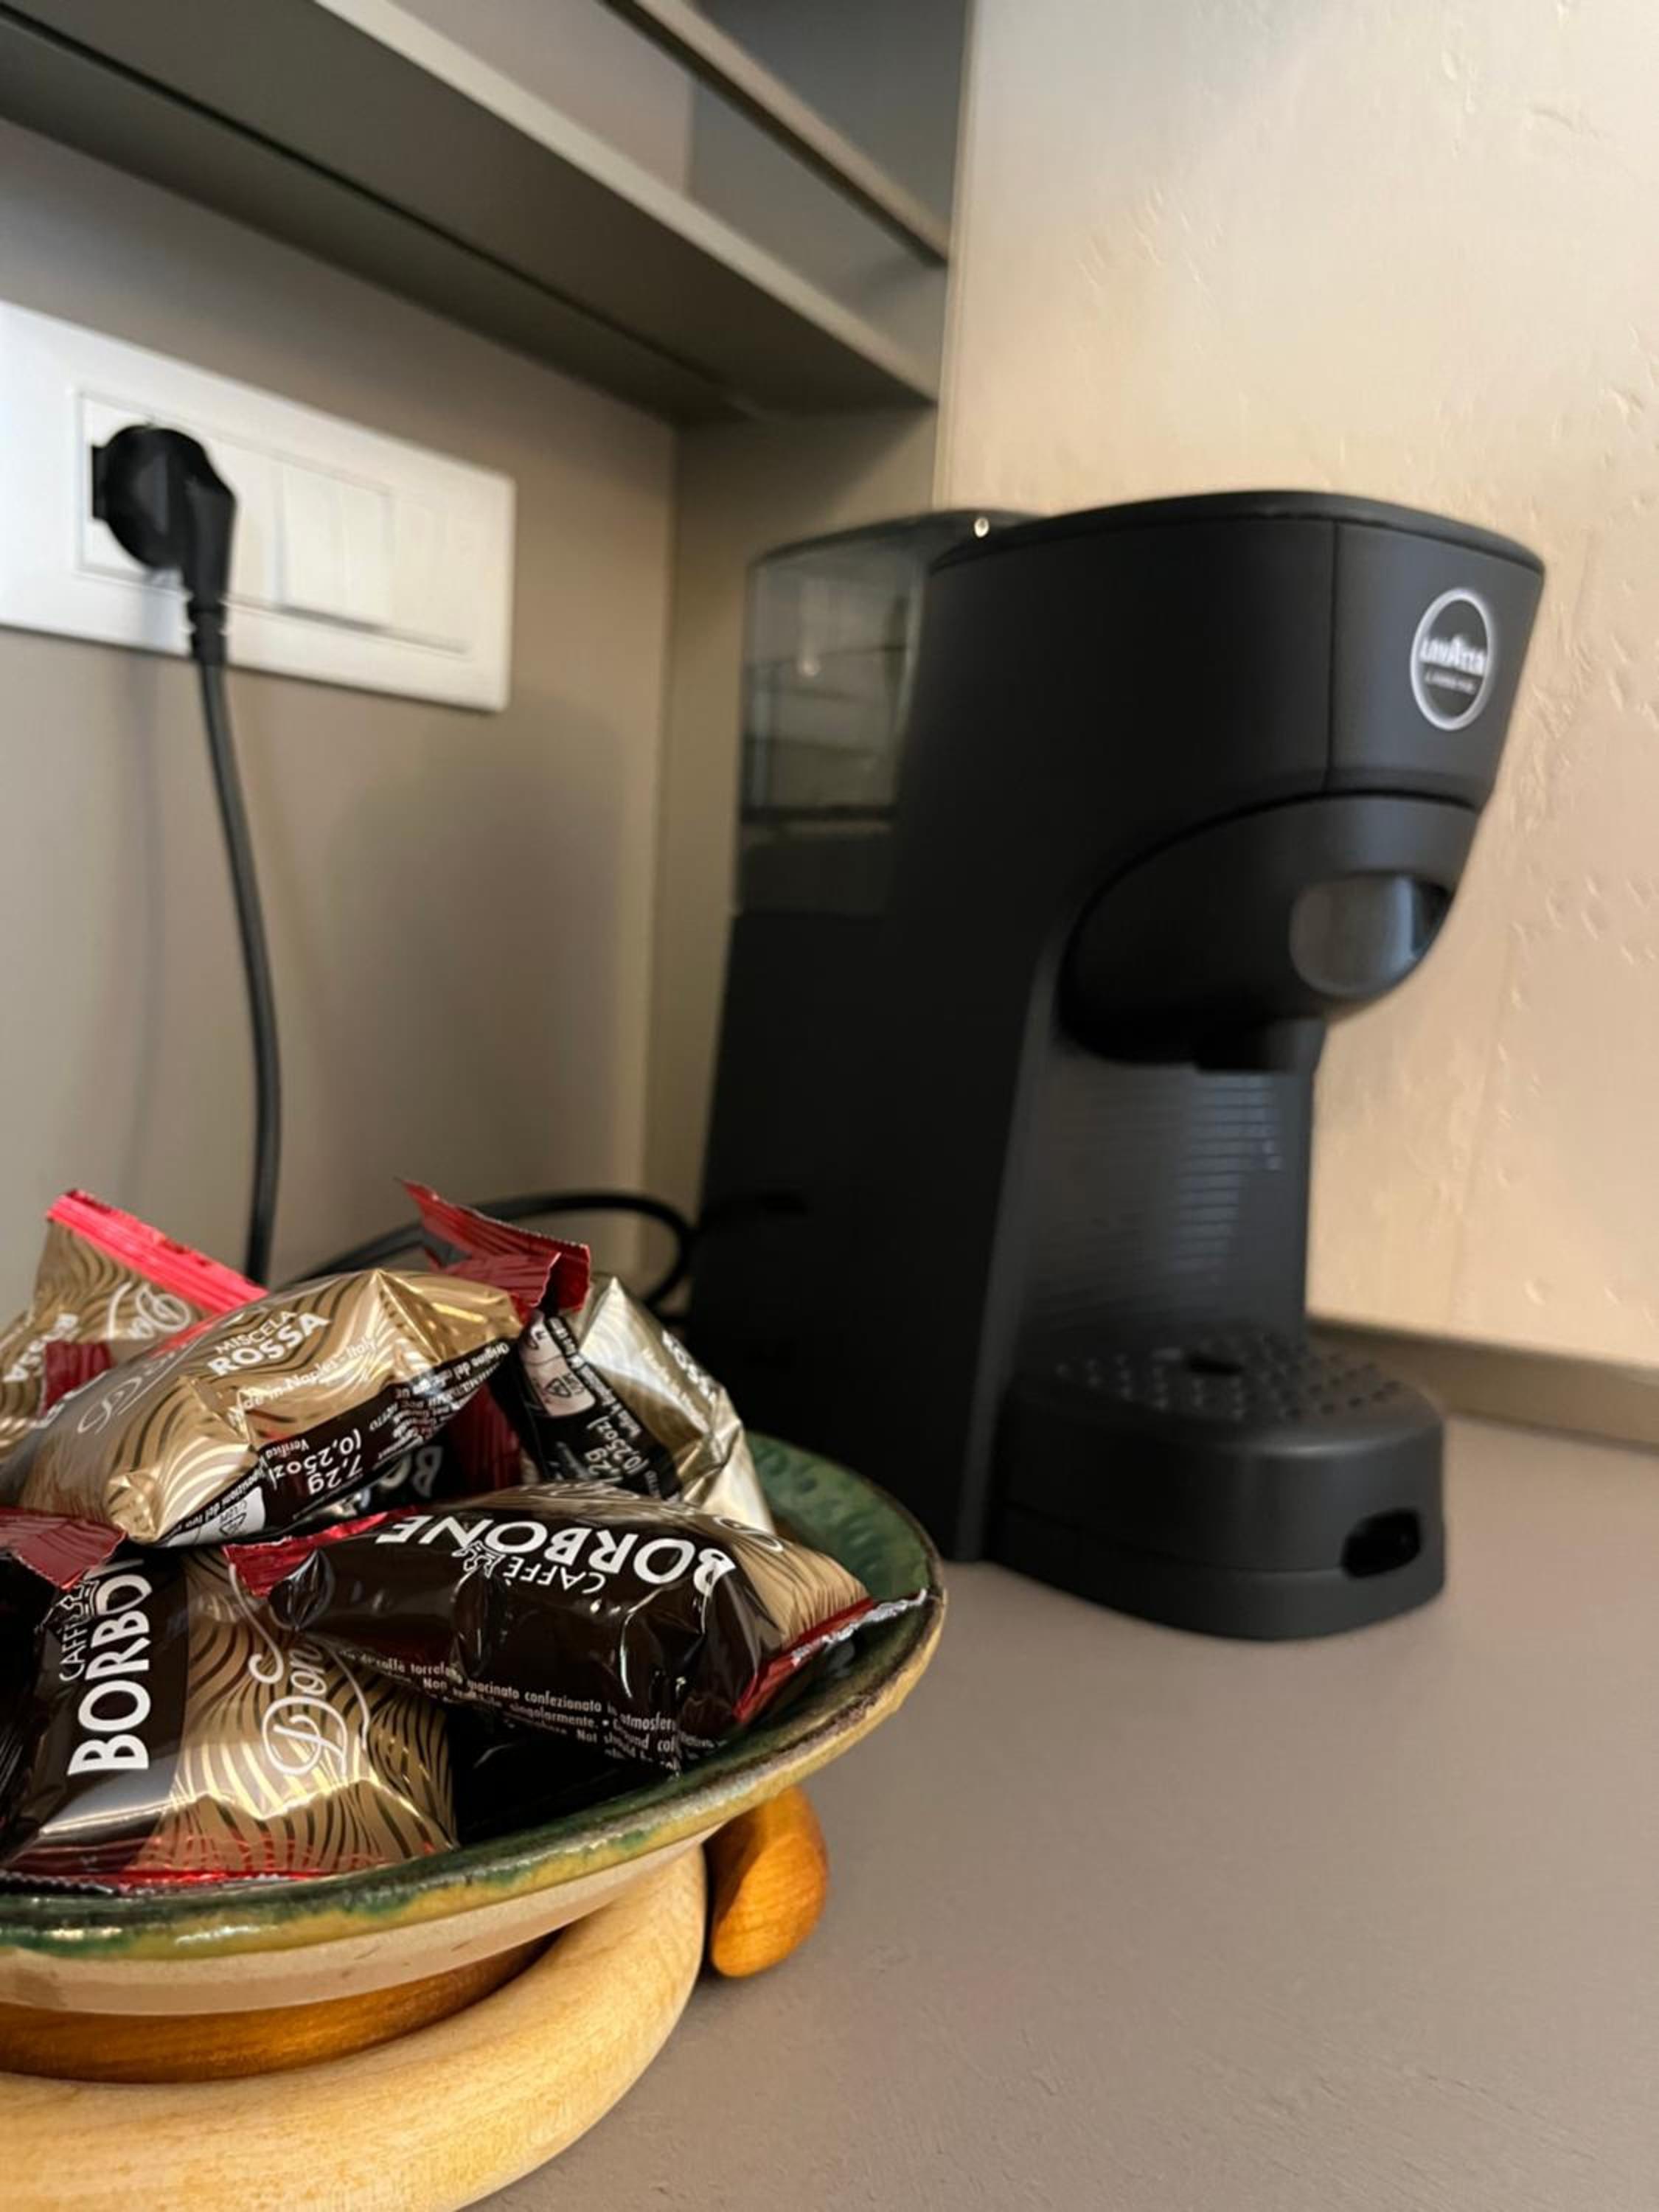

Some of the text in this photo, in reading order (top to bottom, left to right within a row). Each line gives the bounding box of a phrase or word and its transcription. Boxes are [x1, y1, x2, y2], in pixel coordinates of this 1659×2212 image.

[207, 1312, 331, 1377] ROSSA
[215, 1310, 297, 1353] MISCELA
[265, 1439, 310, 1459] Verifica
[268, 1427, 362, 1491] (0,25oz)
[307, 1453, 364, 1495] 7,2g
[375, 1514, 737, 1598] BORBONE
[502, 1556, 606, 1595] CAFFÈ
[524, 1689, 602, 1713] confezionato
